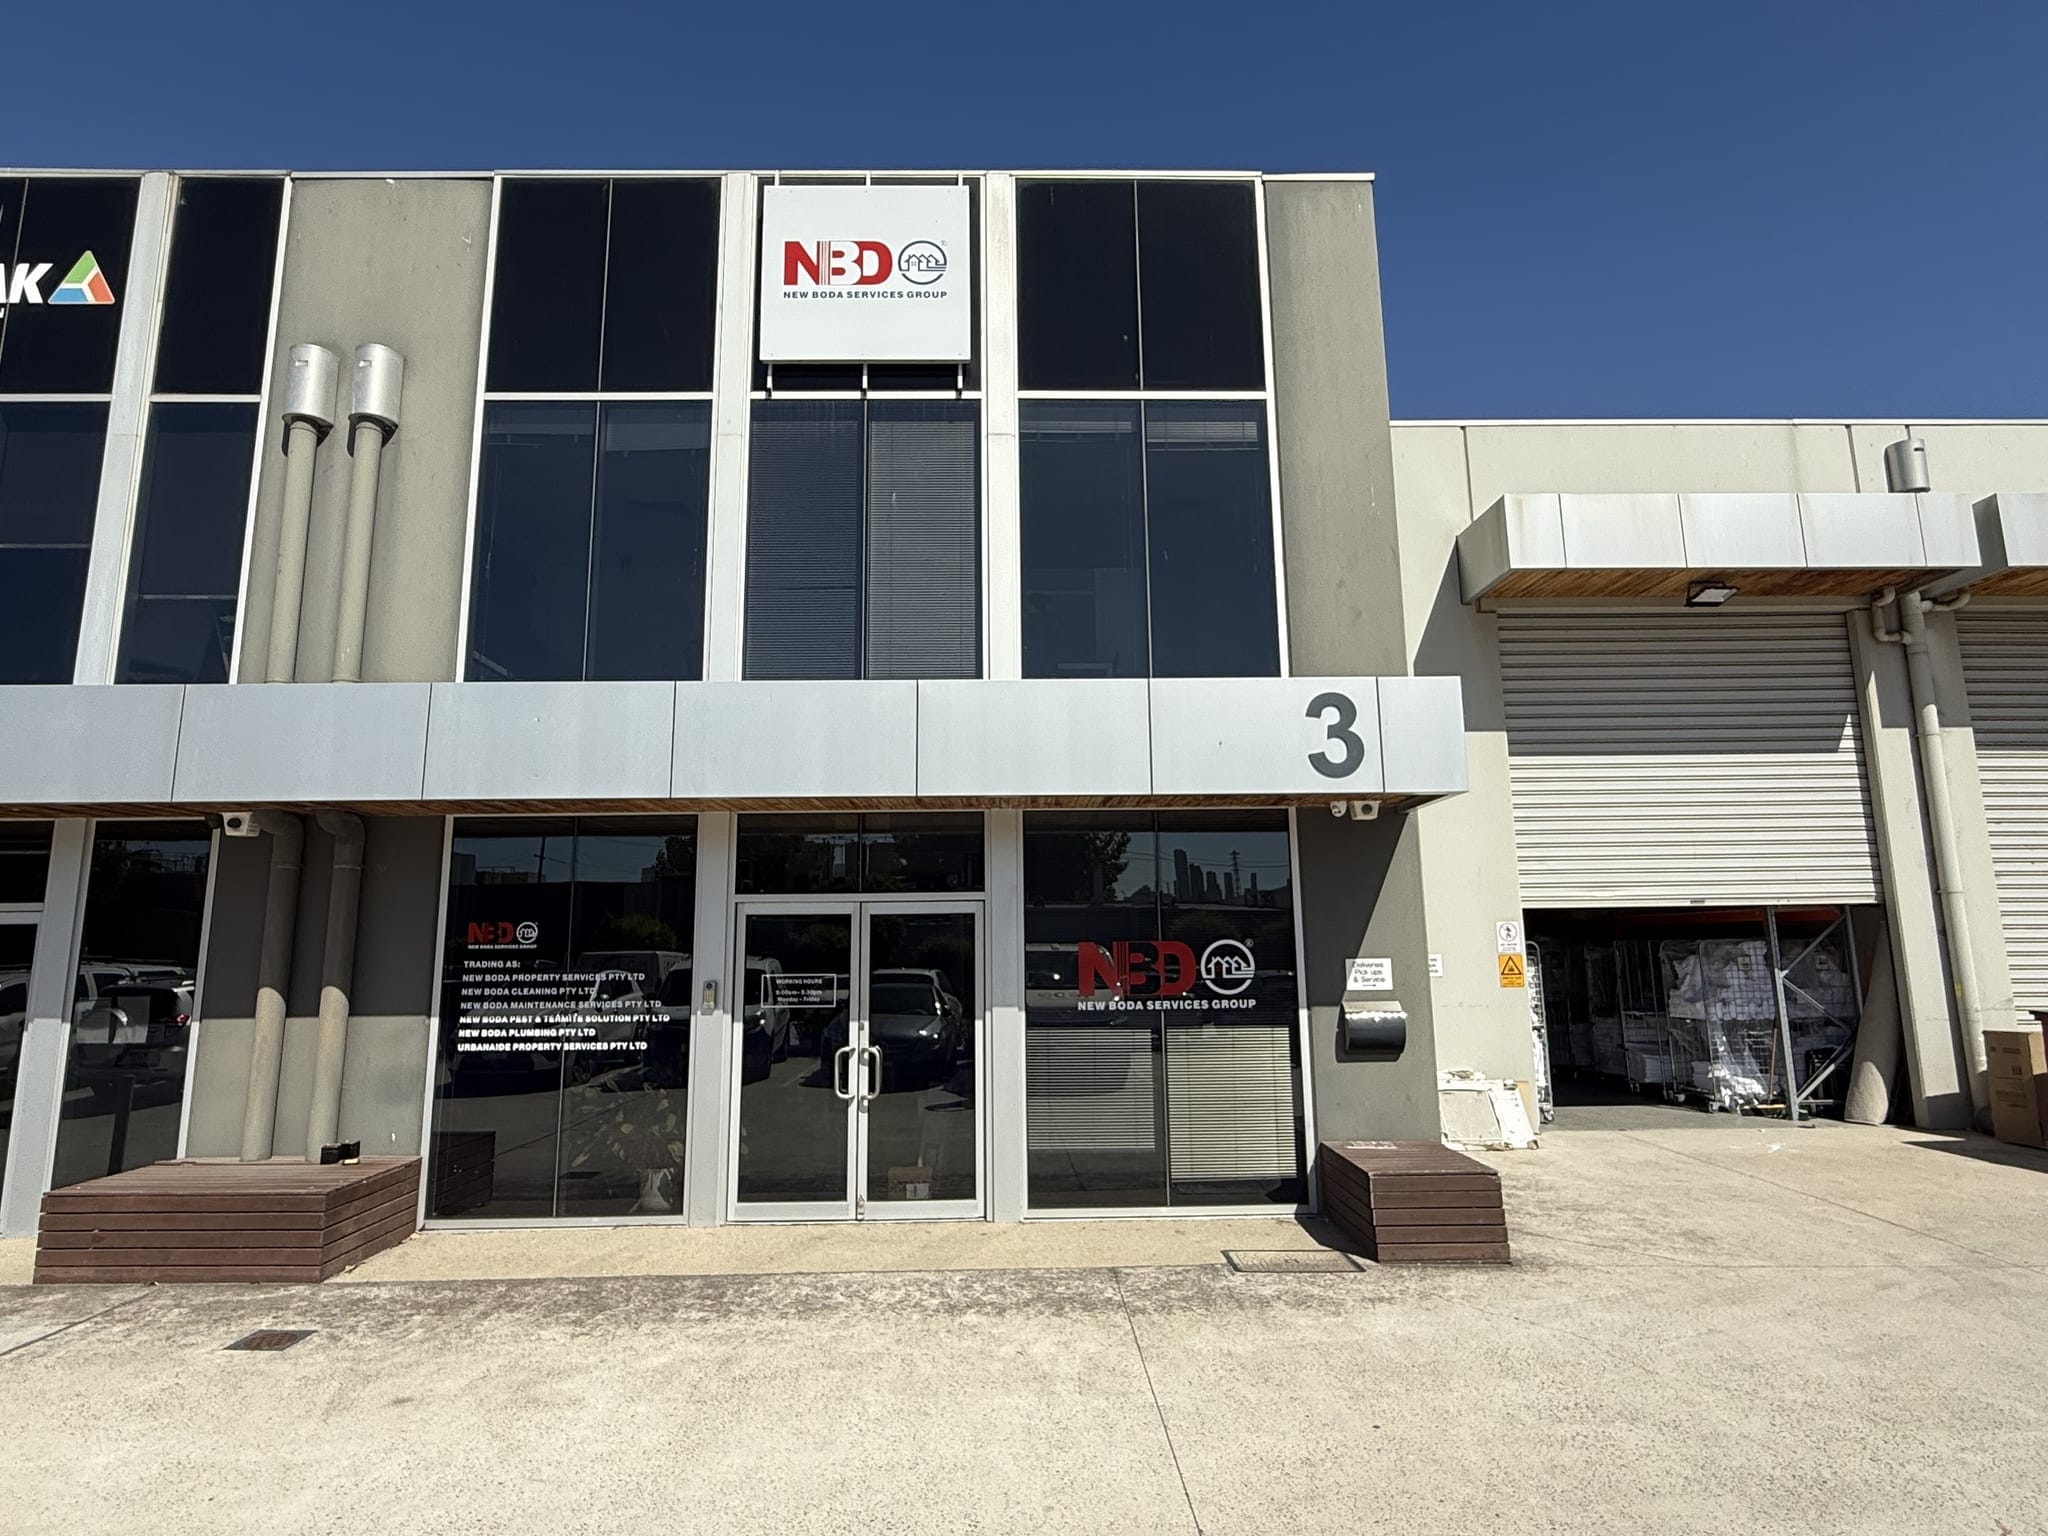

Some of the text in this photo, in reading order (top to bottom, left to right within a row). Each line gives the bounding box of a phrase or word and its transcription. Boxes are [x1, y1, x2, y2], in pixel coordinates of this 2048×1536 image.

[783, 240, 893, 286] NBD
[783, 290, 948, 299] NEW BODA SERVICES GROUP
[1305, 691, 1365, 779] 3
[463, 960, 521, 969] TRADING AS:
[1077, 940, 1197, 997] NBD
[462, 972, 646, 982] NEW BODA PROPERTY SERVICES PTY LTD
[461, 987, 596, 996] NEW BODA CLEANING PTY LTD
[460, 1000, 662, 1010] NEW BODA MAINTENANCE SERVICES PTY LTD
[1077, 999, 1257, 1011] NEW BODA SERVICES GROUP
[459, 1015, 481, 1024] NEW
[481, 1015, 508, 1024] BODA
[509, 1015, 533, 1023] PEST
[543, 1013, 584, 1023] TERMITE
[585, 1014, 632, 1023] SOLUTION
[632, 1014, 651, 1022] PTY
[651, 1013, 671, 1022] LTD
[458, 1028, 597, 1037] NEW BODA PLUMBING PTY LTD
[457, 1041, 648, 1052] URBANAIDE PROPERTY SERVICES PTY LTD
